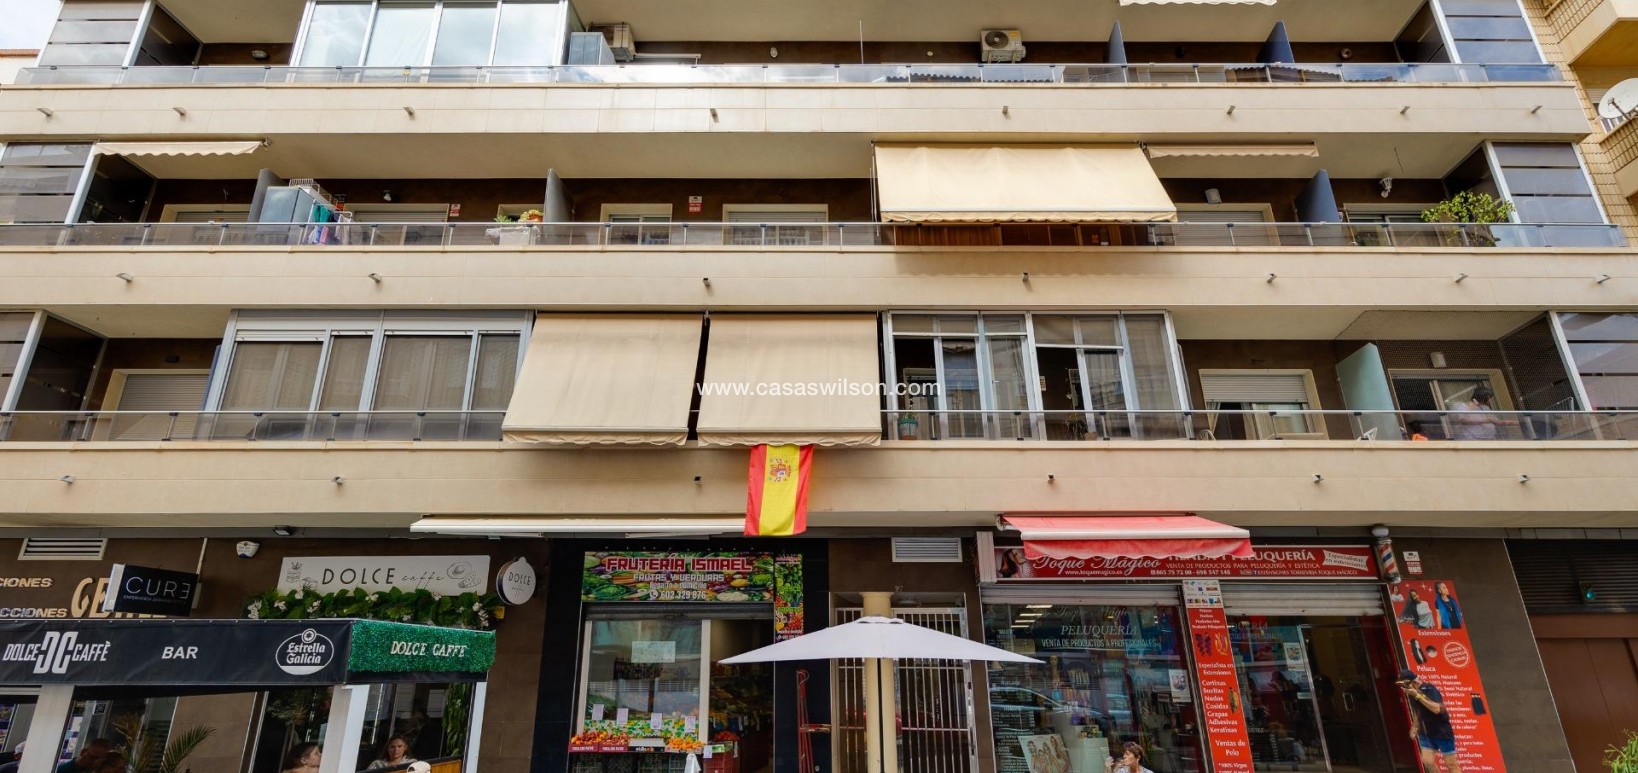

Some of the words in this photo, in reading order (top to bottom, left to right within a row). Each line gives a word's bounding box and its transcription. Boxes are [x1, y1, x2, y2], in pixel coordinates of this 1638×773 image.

[606, 554, 686, 572] FRUTERÍA
[690, 557, 752, 572] ISMAEL
[1231, 550, 1316, 562] PLUQUERÍA
[1032, 556, 1085, 574] Toque
[1090, 556, 1161, 576] Mágico
[322, 568, 396, 584] DOLCE
[402, 572, 444, 590] caffe
[508, 571, 532, 586] DOLCE
[633, 574, 666, 582] FRUTAS
[670, 574, 677, 582] Y
[679, 574, 724, 582] VERDURAS
[1061, 624, 1137, 637] PELUQUERÍA
[286, 642, 326, 654] Estrella
[390, 641, 426, 656] DOLCE
[1041, 639, 1061, 648] VENTA
[1062, 639, 1070, 648] DE
[1070, 639, 1104, 648] PRODUCTOS
[1106, 640, 1111, 648] A
[1112, 639, 1157, 648] PROFESIONALES
[3, 644, 42, 661] DOLCE
[72, 640, 112, 662] CAFFÈ
[162, 646, 198, 660] BAR
[286, 652, 322, 665] Galicia
